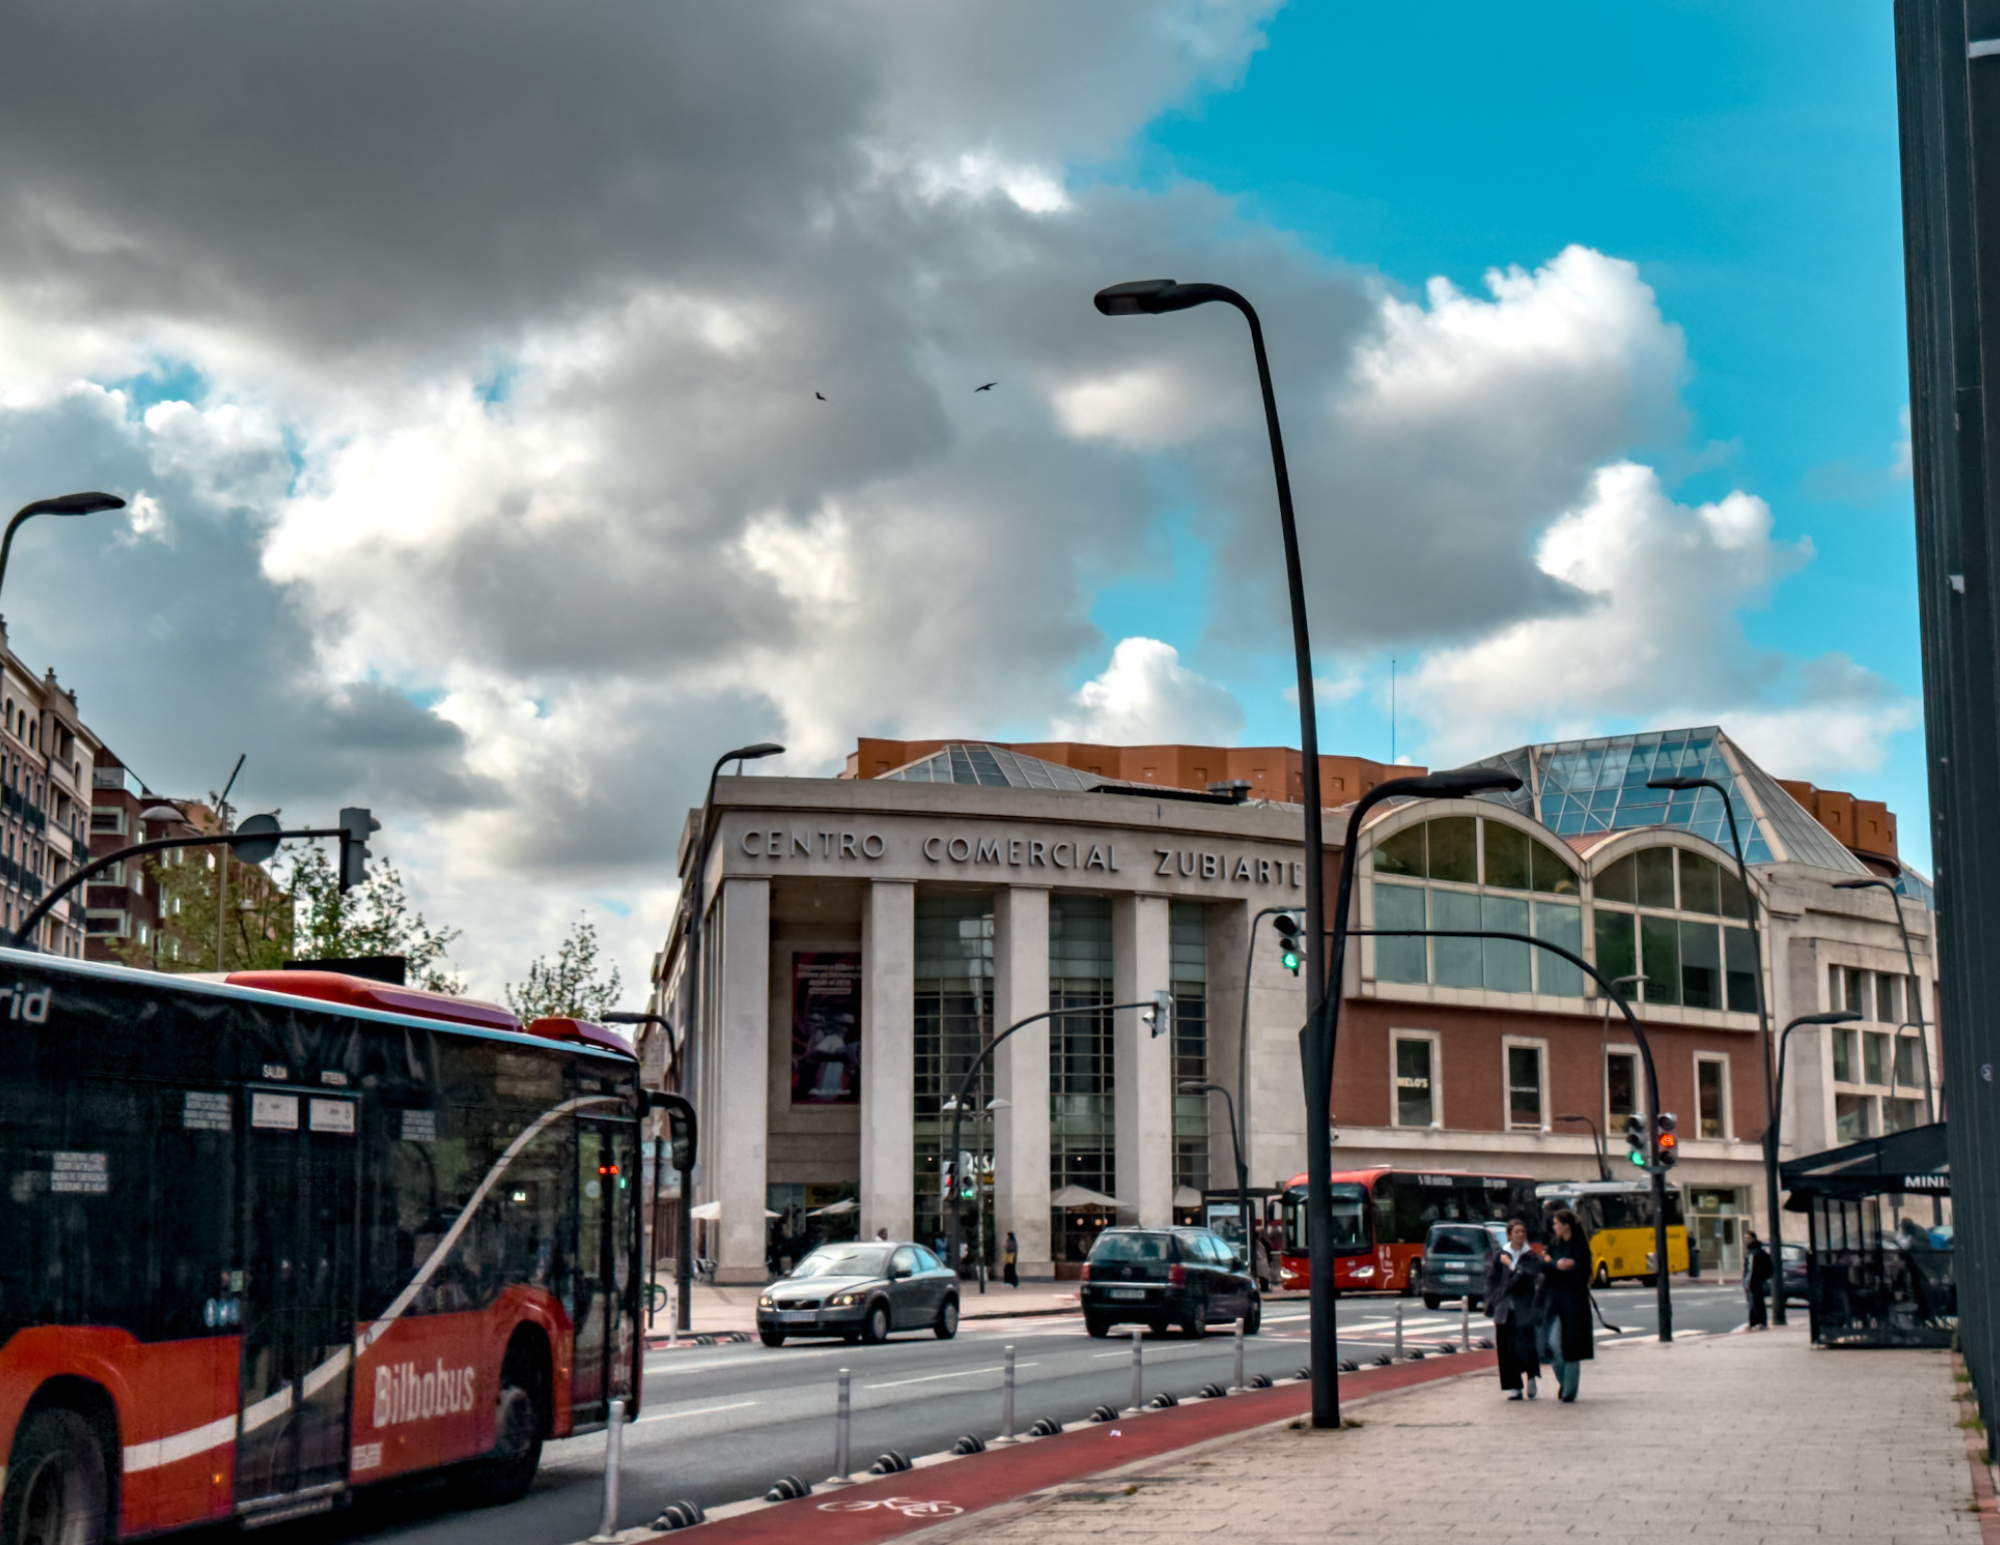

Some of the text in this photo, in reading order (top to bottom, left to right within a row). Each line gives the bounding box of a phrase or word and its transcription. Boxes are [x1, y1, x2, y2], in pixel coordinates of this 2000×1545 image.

[740, 829, 1304, 889] CENTRO COMERCIAL ZUBIARTE
[262, 1064, 288, 1080] SALIDA
[373, 1358, 475, 1428] Bilbobus
